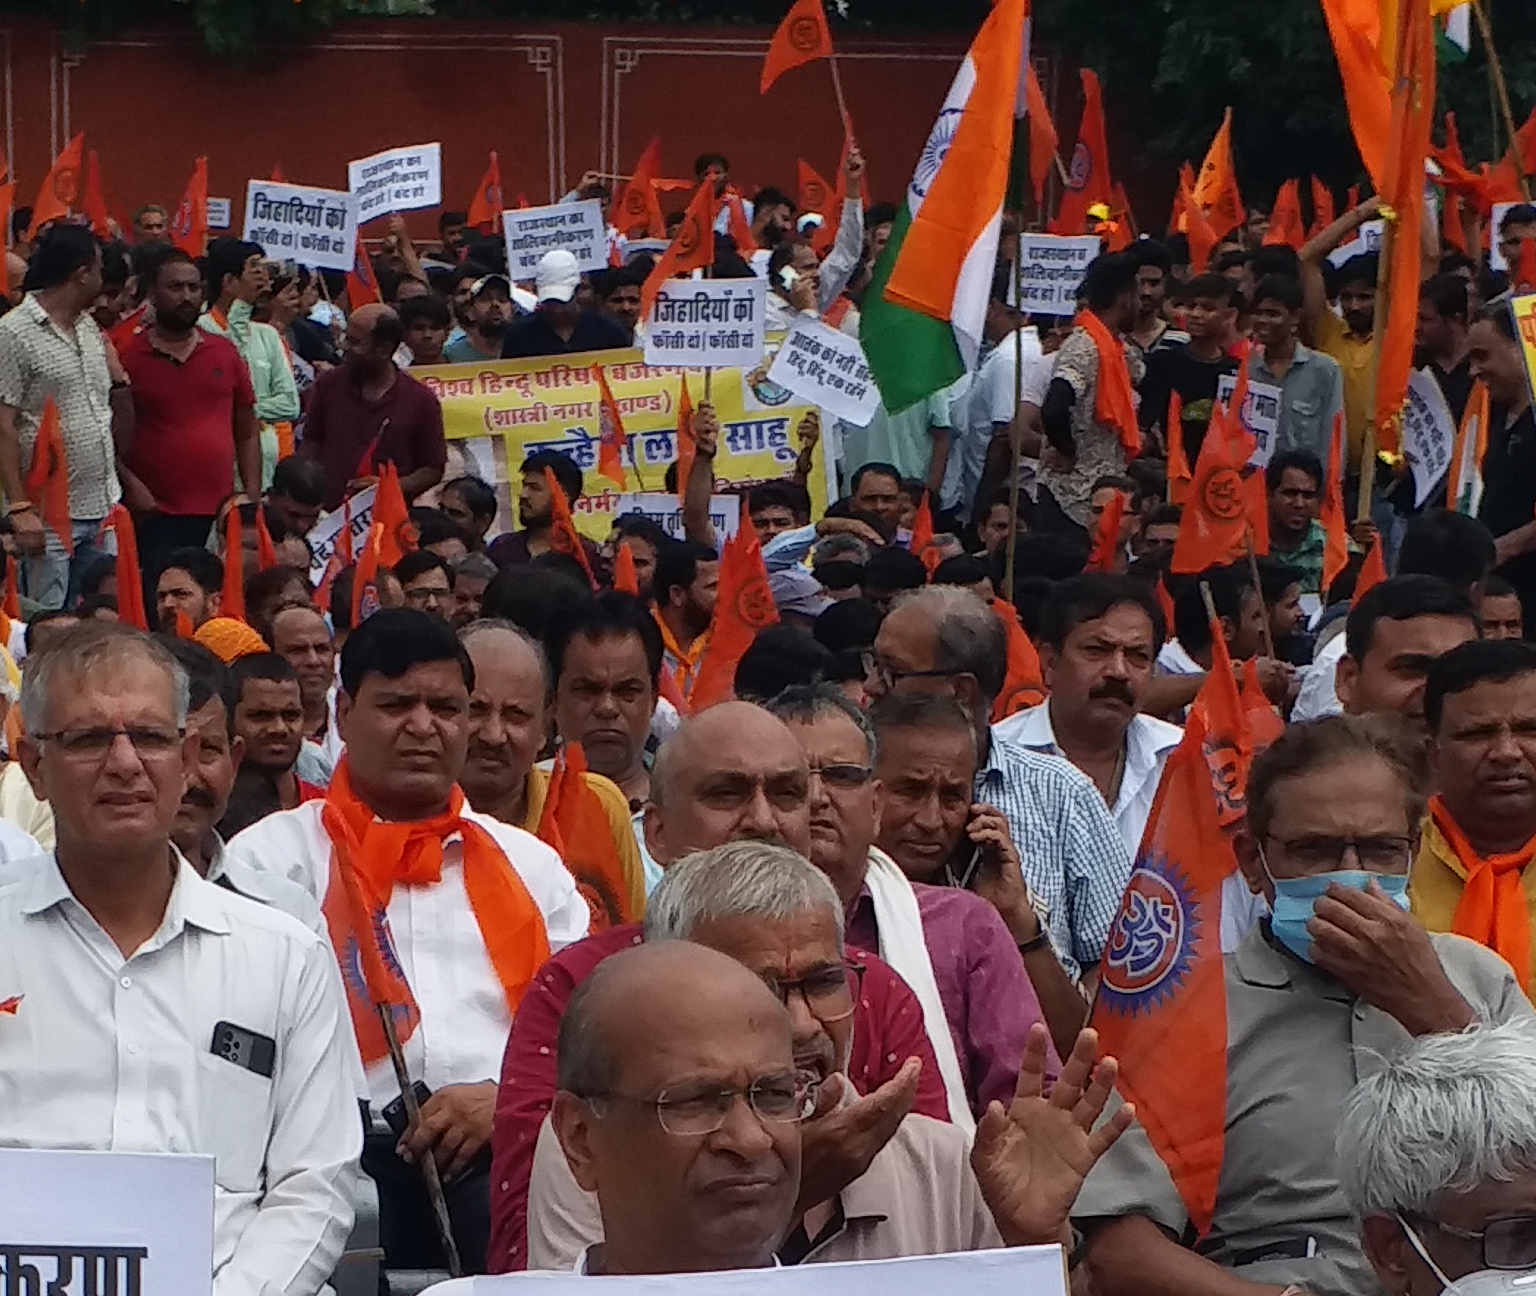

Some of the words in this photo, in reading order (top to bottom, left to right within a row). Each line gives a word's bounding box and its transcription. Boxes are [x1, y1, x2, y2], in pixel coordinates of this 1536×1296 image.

[252, 191, 325, 228] जिहादियों
[325, 201, 347, 231] को
[654, 290, 733, 323] जिहादियों
[733, 288, 755, 322] को
[479, 371, 535, 398] हिन्दू
[551, 402, 593, 420] नगर
[724, 417, 798, 461] साहू
